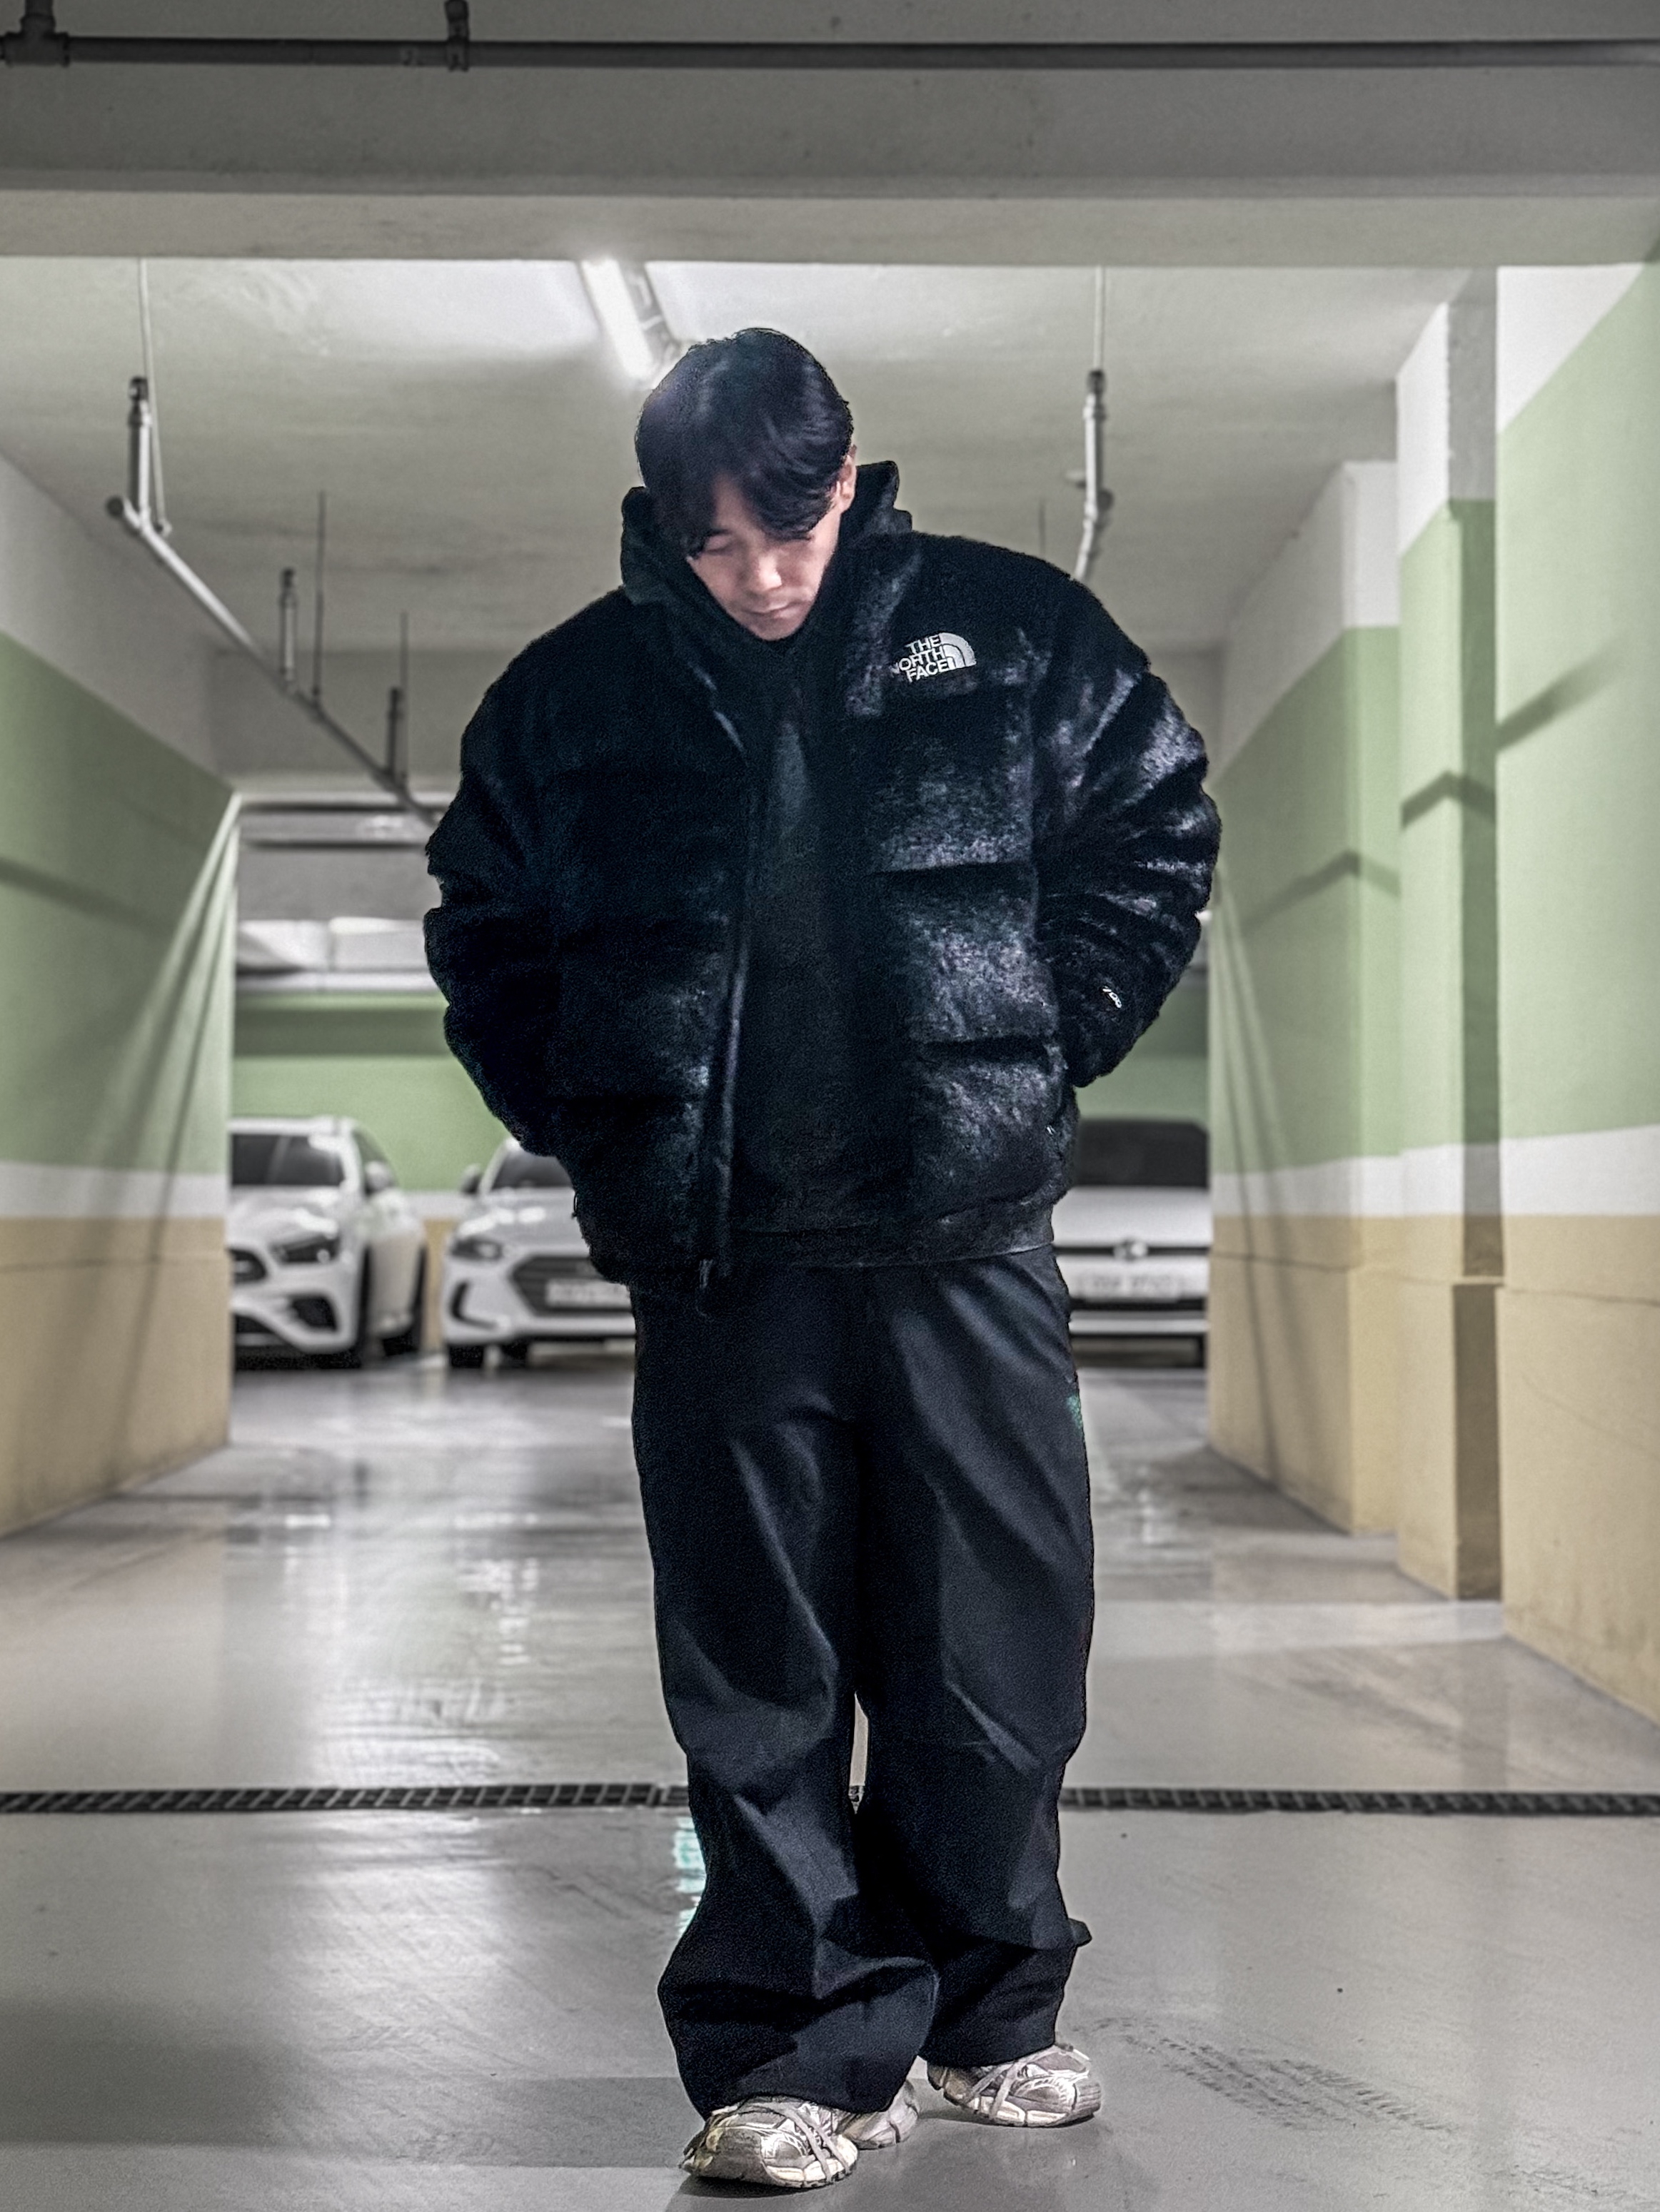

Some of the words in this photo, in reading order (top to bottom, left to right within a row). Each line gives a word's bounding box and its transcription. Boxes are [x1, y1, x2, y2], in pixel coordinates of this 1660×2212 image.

[905, 635, 941, 655] THE
[890, 645, 945, 675] NORTH
[905, 658, 950, 683] FACE
